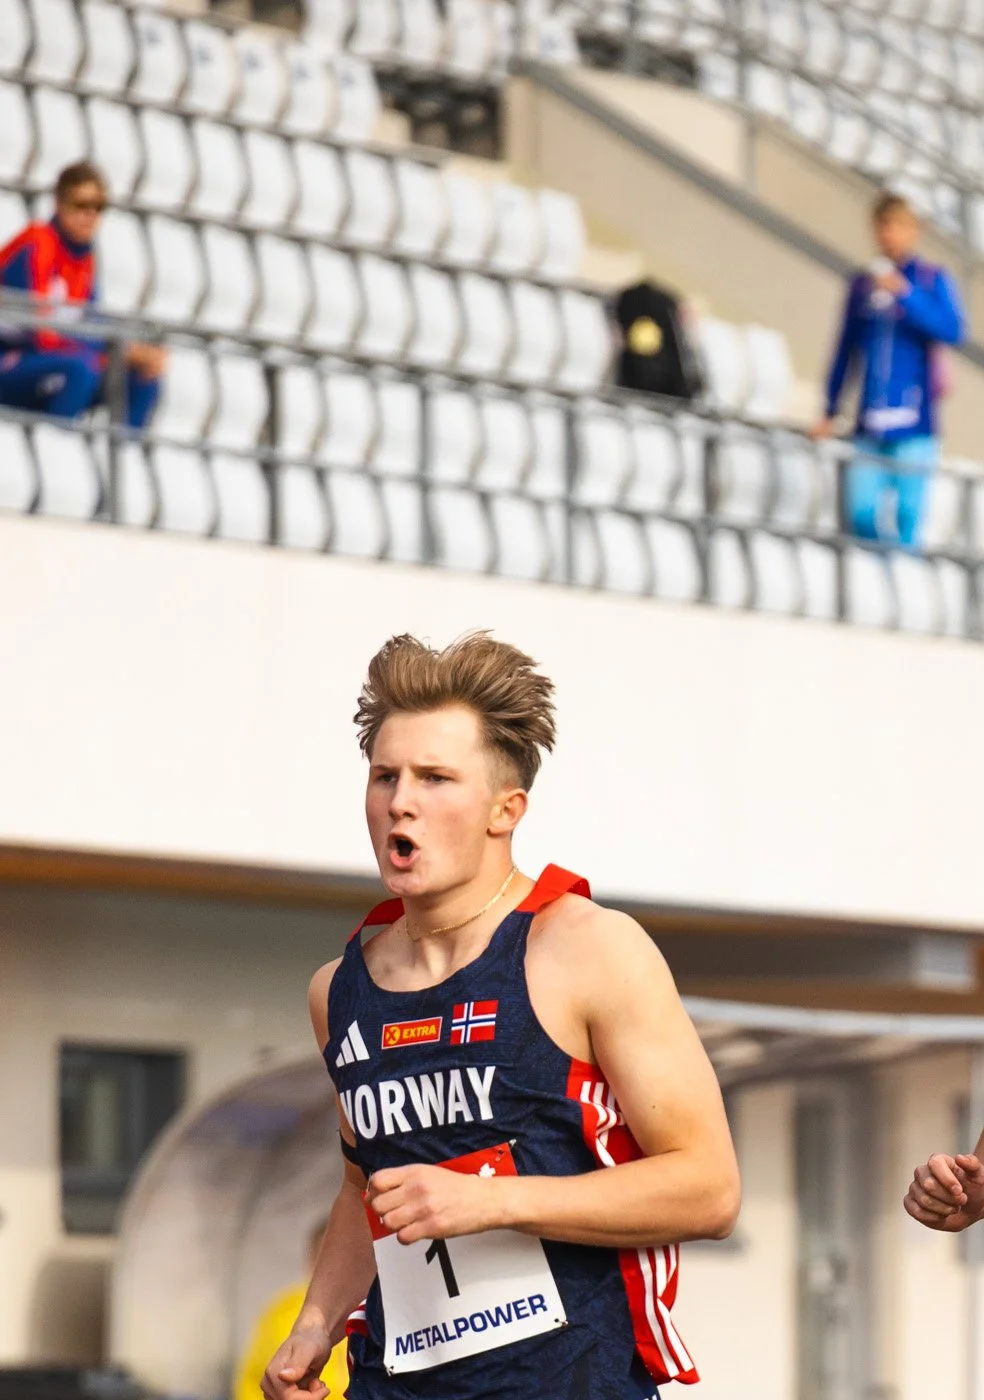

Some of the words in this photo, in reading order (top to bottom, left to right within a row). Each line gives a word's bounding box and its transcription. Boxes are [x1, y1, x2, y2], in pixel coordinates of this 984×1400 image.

[402, 1024, 437, 1039] EXTRA
[339, 1065, 496, 1140] NORWAY
[425, 1237, 460, 1298] 1
[395, 1294, 548, 1356] METALPOWER
